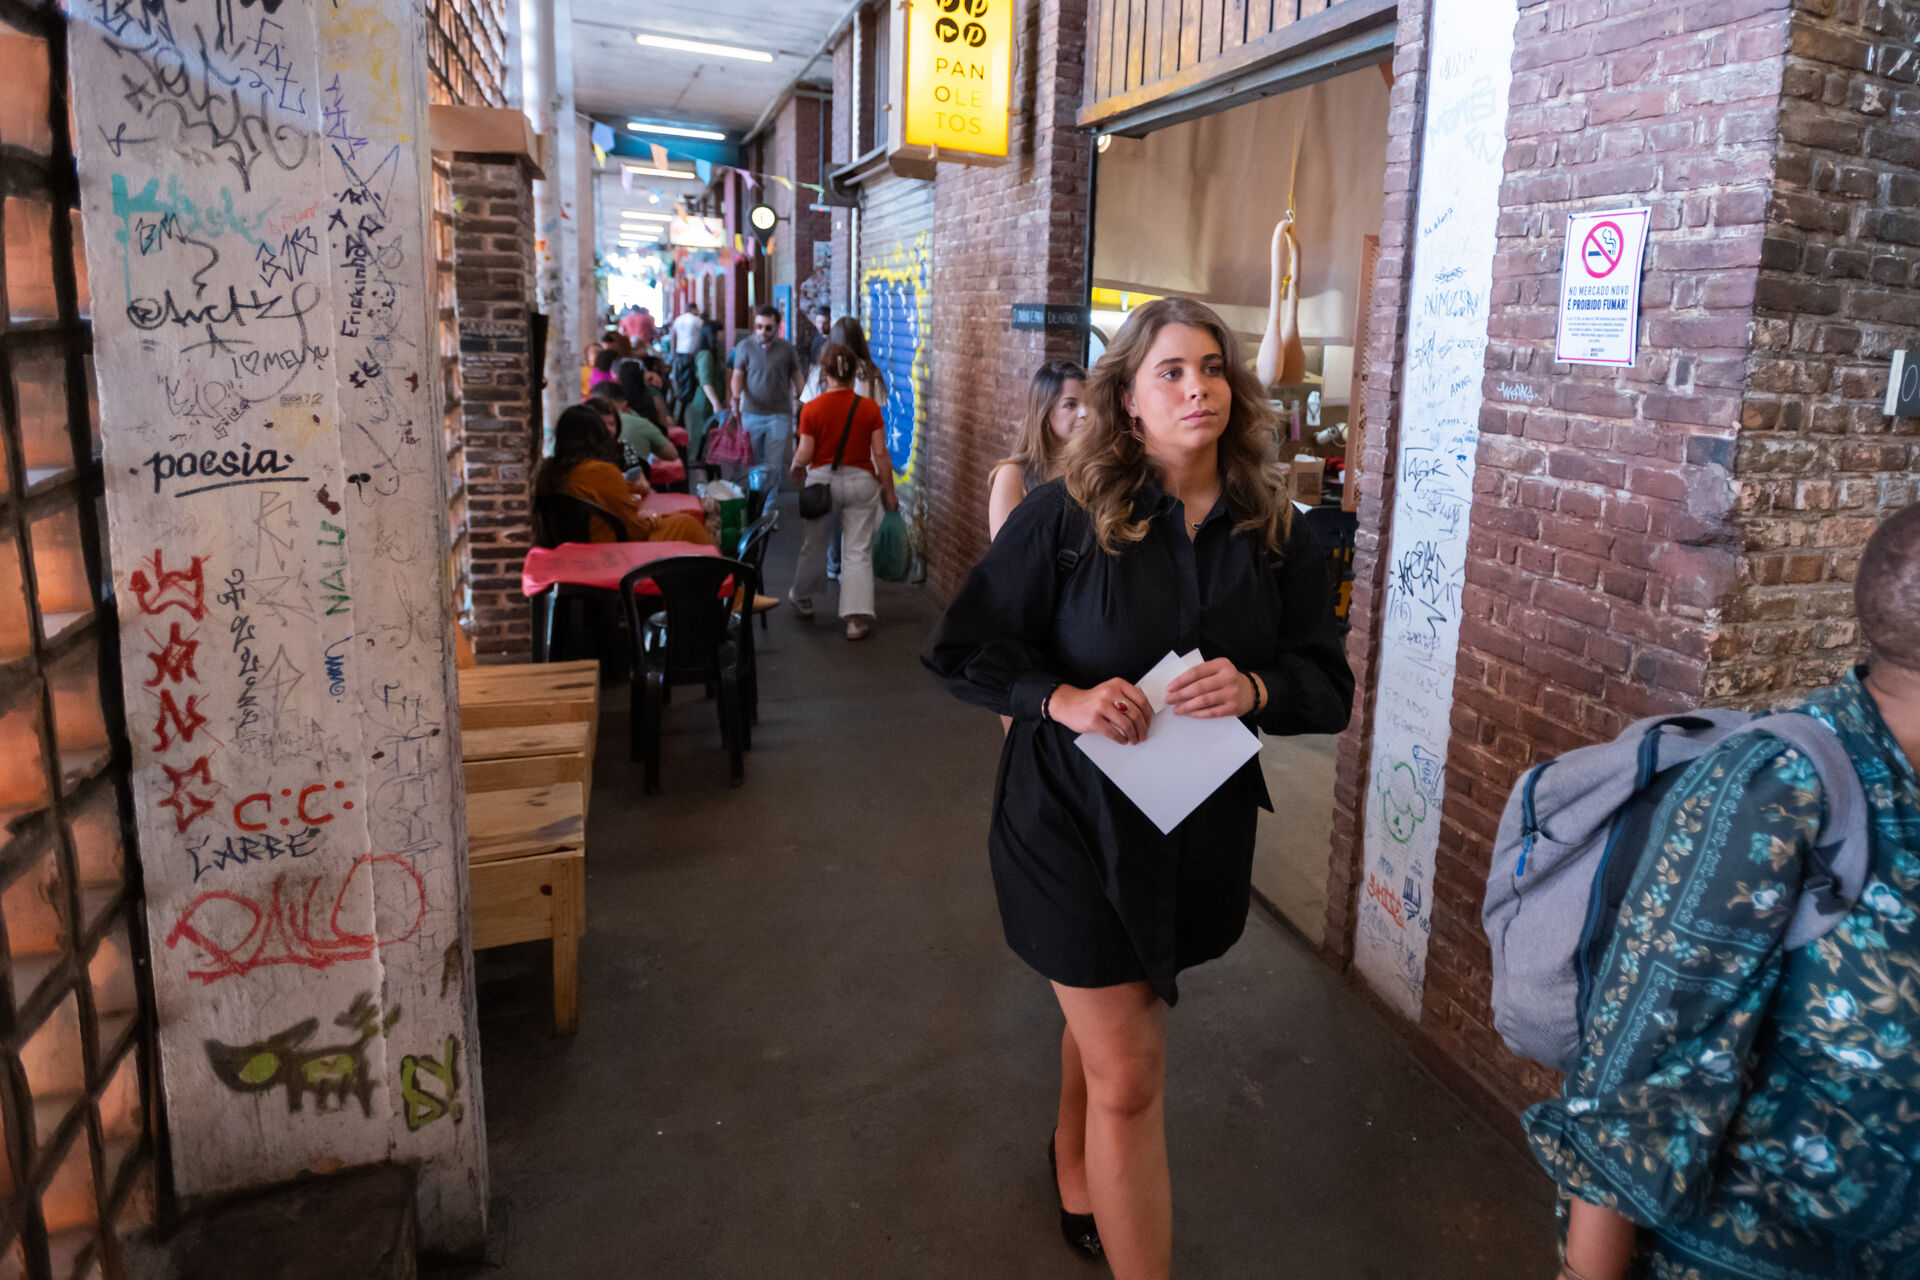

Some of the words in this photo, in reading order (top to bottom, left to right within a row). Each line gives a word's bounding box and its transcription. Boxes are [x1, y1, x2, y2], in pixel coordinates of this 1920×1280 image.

[936, 57, 984, 80] PAN
[934, 85, 984, 108] OLE
[934, 111, 982, 136] TOS
[1569, 286, 1577, 296] NO
[1579, 285, 1610, 296] MERCADO
[1611, 284, 1630, 296] NOVO
[1567, 297, 1572, 310] É
[1573, 299, 1602, 310] PROIBIDO
[1603, 298, 1629, 310] FUMAR!
